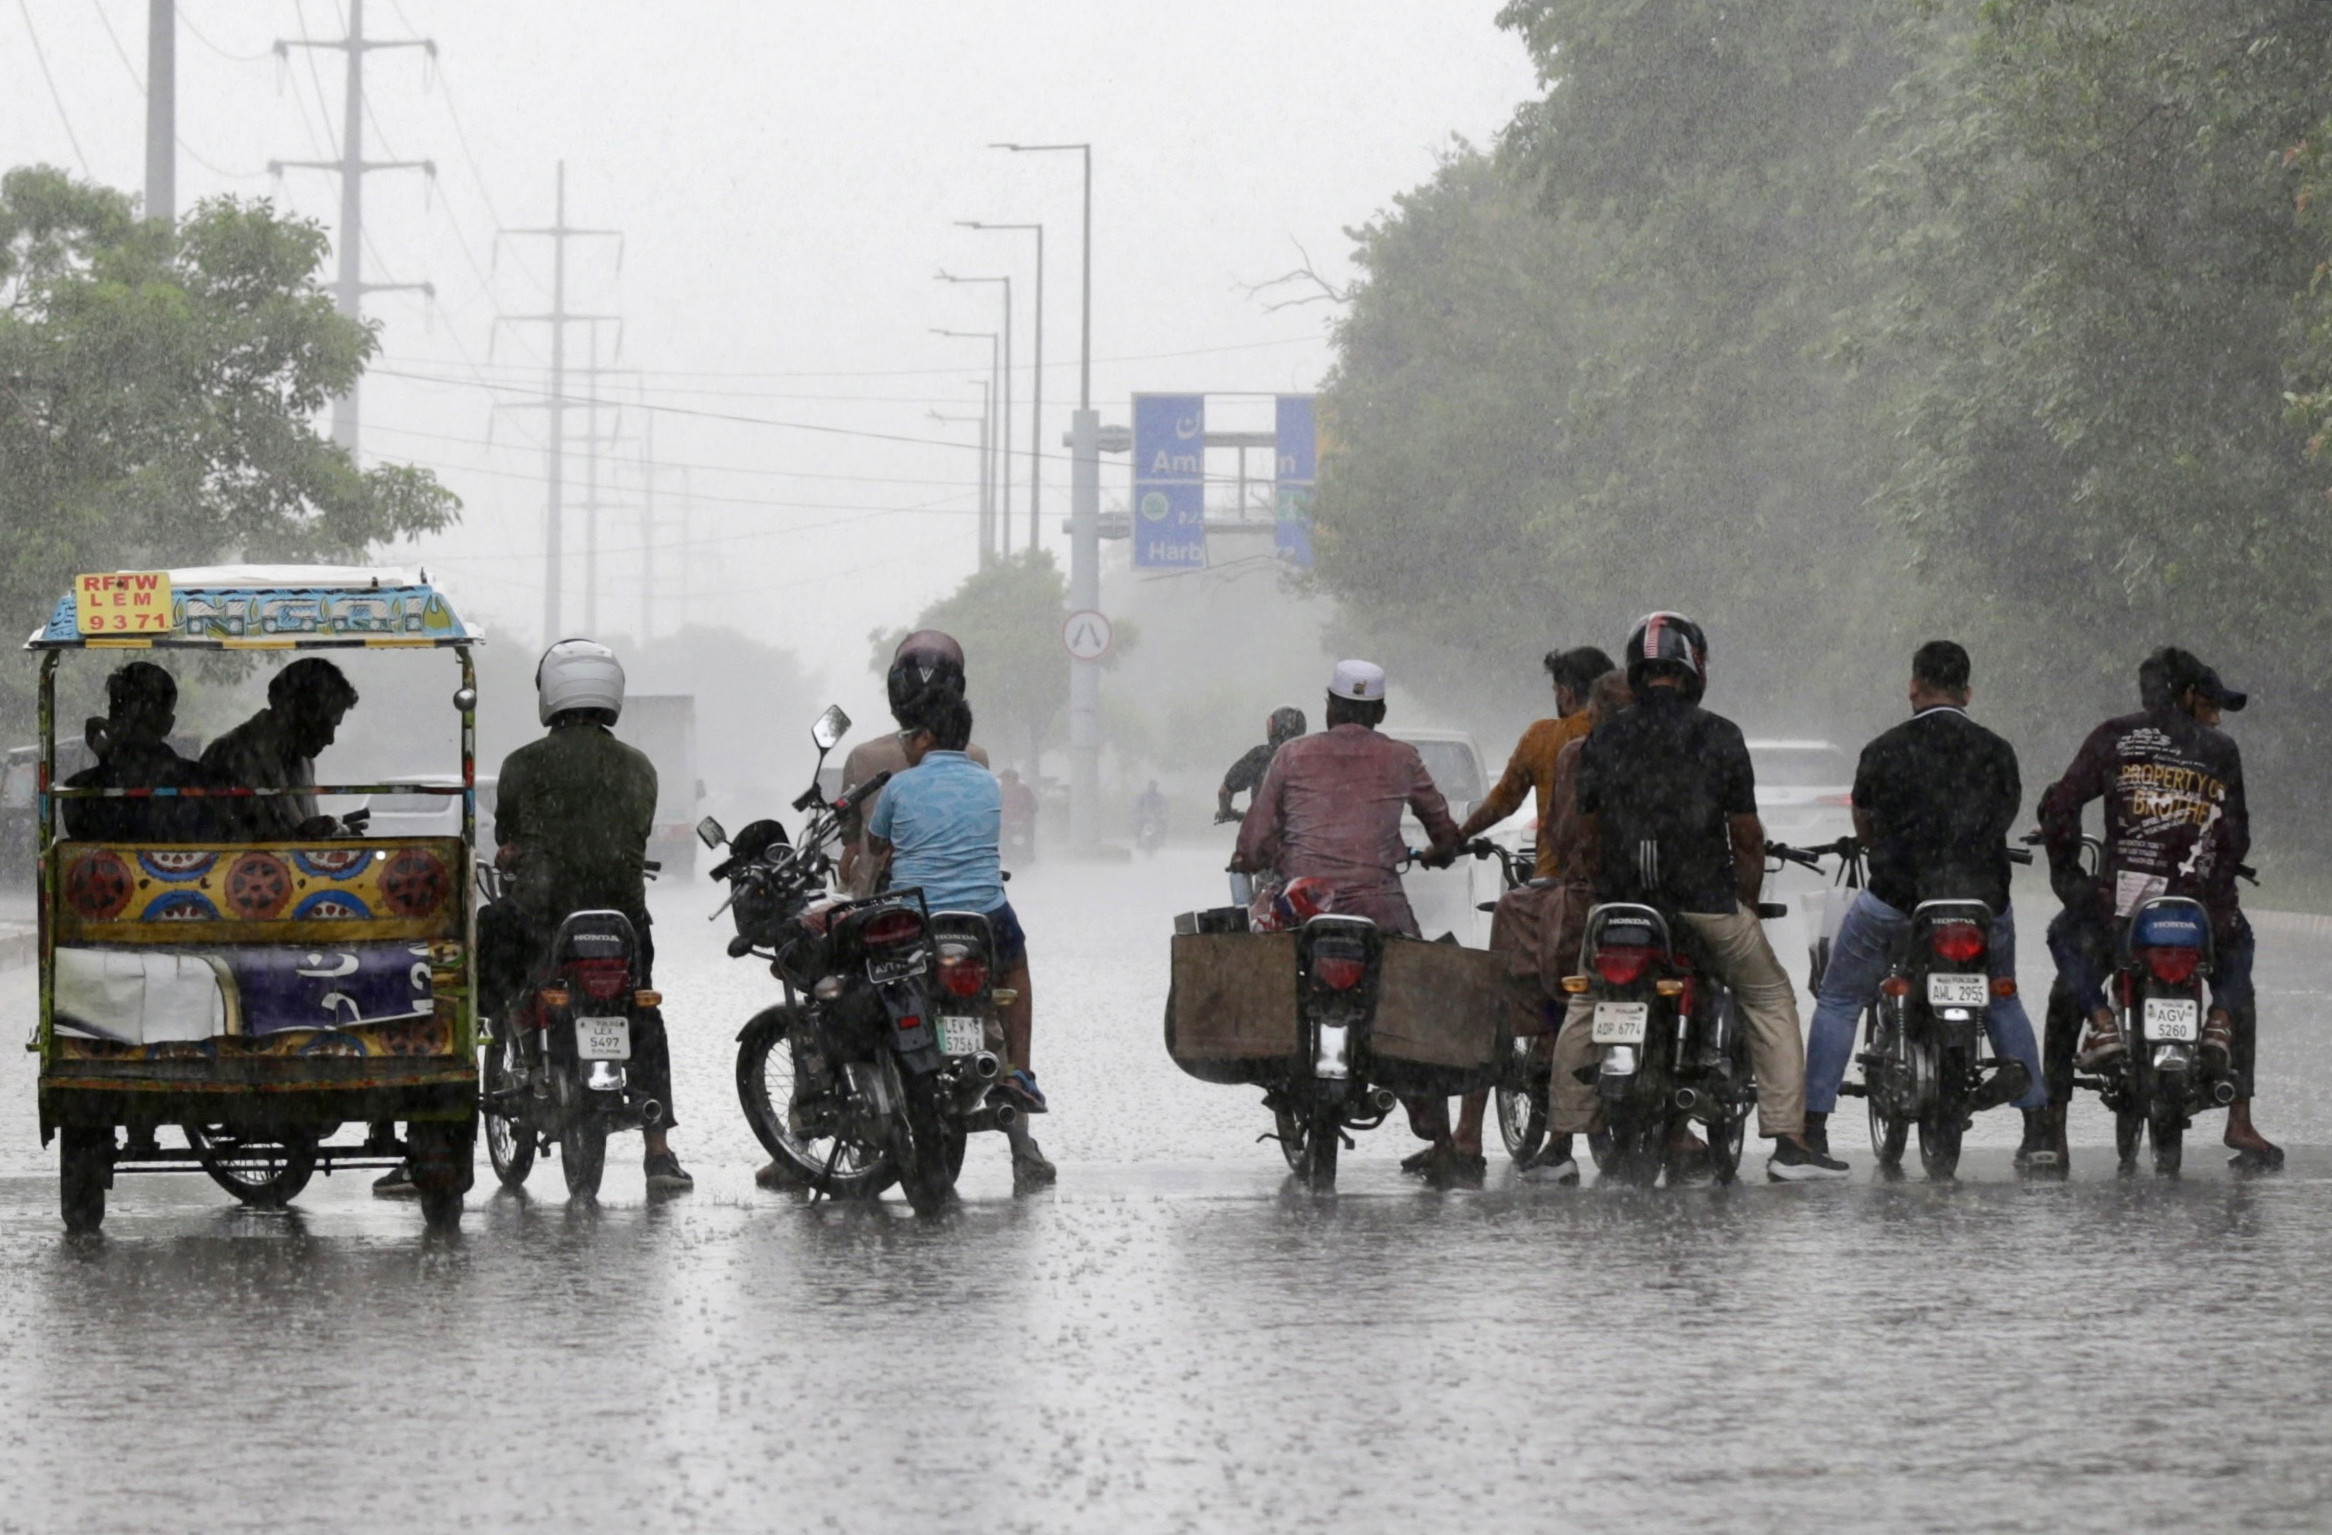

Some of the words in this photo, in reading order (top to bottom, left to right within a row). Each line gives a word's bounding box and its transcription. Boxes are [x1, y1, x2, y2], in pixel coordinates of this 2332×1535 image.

[2121, 764, 2208, 796] PROPERTY
[1608, 918, 1651, 926] HONDA
[1931, 917, 1977, 925] HONDA
[2153, 921, 2198, 929] HONDA
[573, 934, 620, 942] HONDA
[2157, 1009, 2186, 1022] AGV
[2158, 1024, 2187, 1037] 5260
[590, 1037, 620, 1048] 5497
